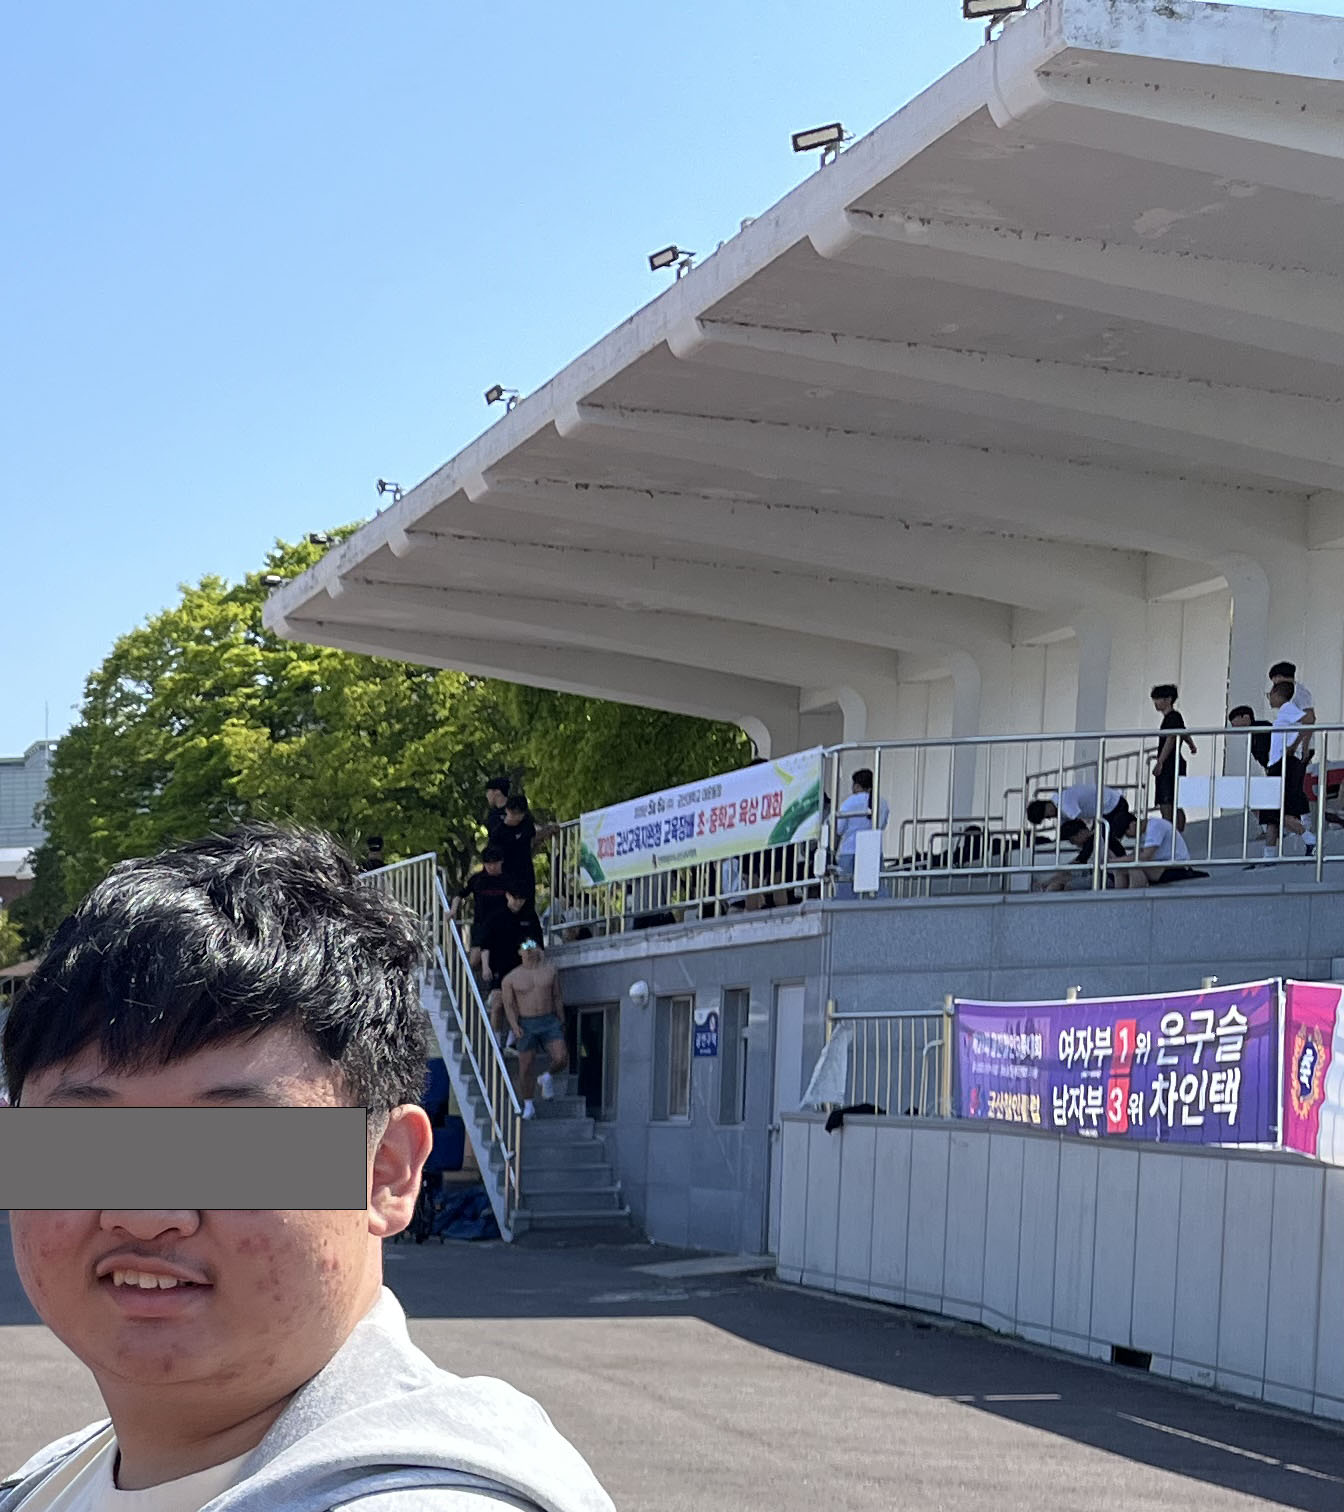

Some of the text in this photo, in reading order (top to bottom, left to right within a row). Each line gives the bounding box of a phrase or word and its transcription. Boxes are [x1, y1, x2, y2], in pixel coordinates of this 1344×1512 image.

[1058, 1025, 1112, 1069] 여자부
[1157, 1004, 1248, 1066] 은구슬
[1053, 1084, 1104, 1126] 남자부
[1149, 1067, 1241, 1127] 차인택
